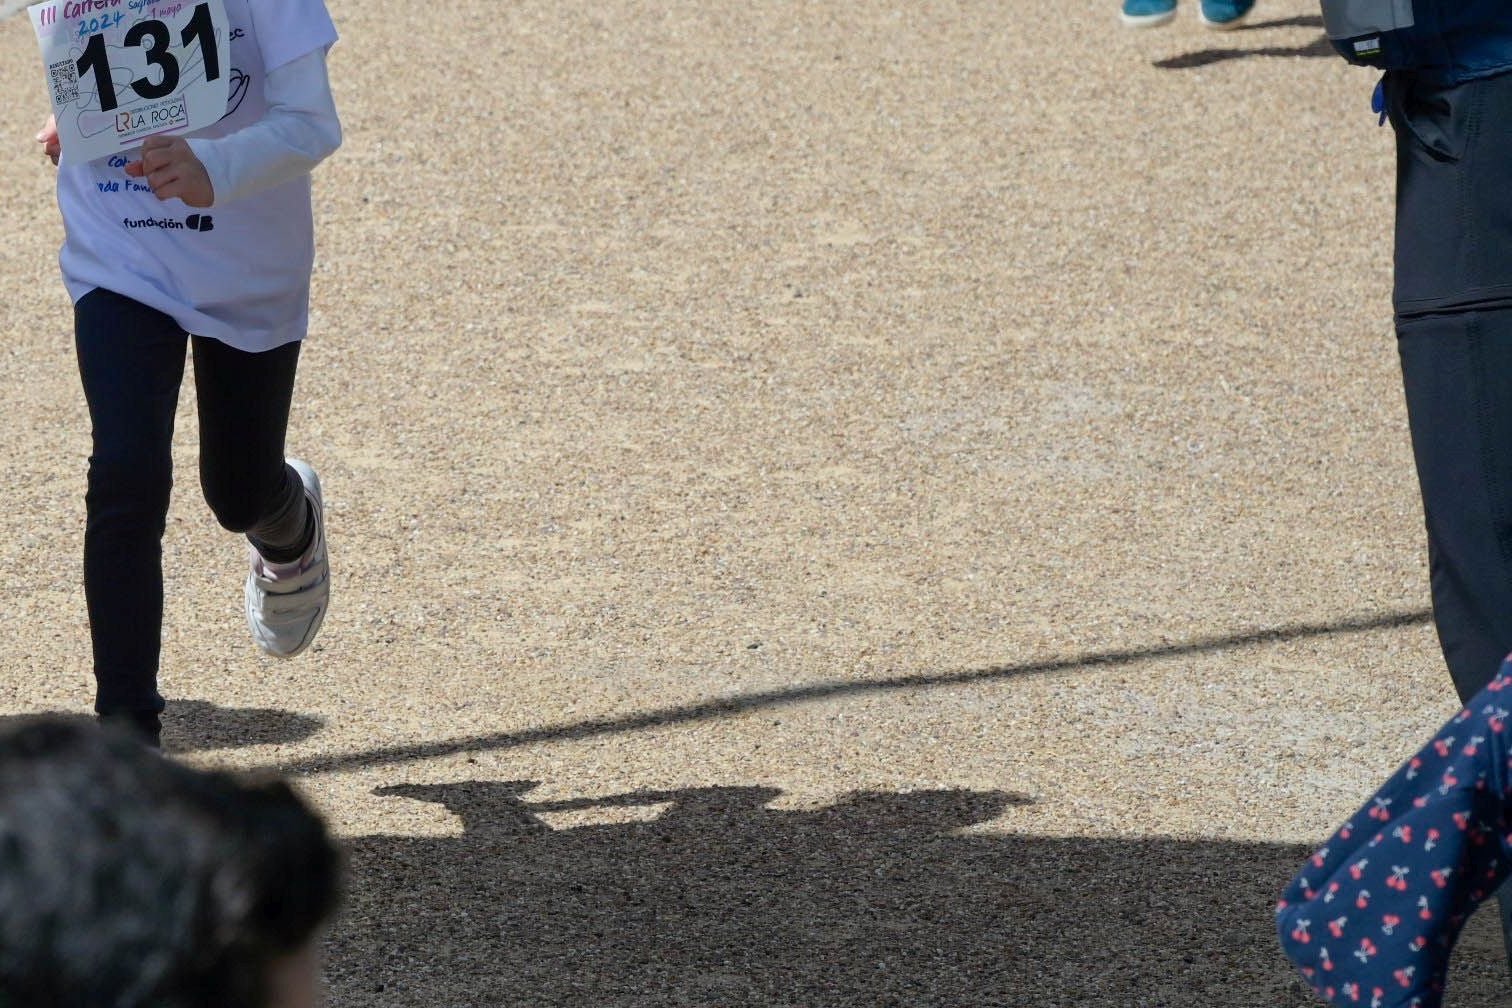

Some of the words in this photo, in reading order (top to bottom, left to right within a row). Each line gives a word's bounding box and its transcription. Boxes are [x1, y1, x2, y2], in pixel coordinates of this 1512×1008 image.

[40, 5, 57, 26] III
[150, 7, 157, 19] 1
[159, 3, 183, 19] mayo
[77, 11, 126, 36] 2024
[76, 1, 220, 113] 131
[131, 114, 146, 129] LA
[151, 103, 185, 123] ROCA
[123, 216, 184, 230] fundación
